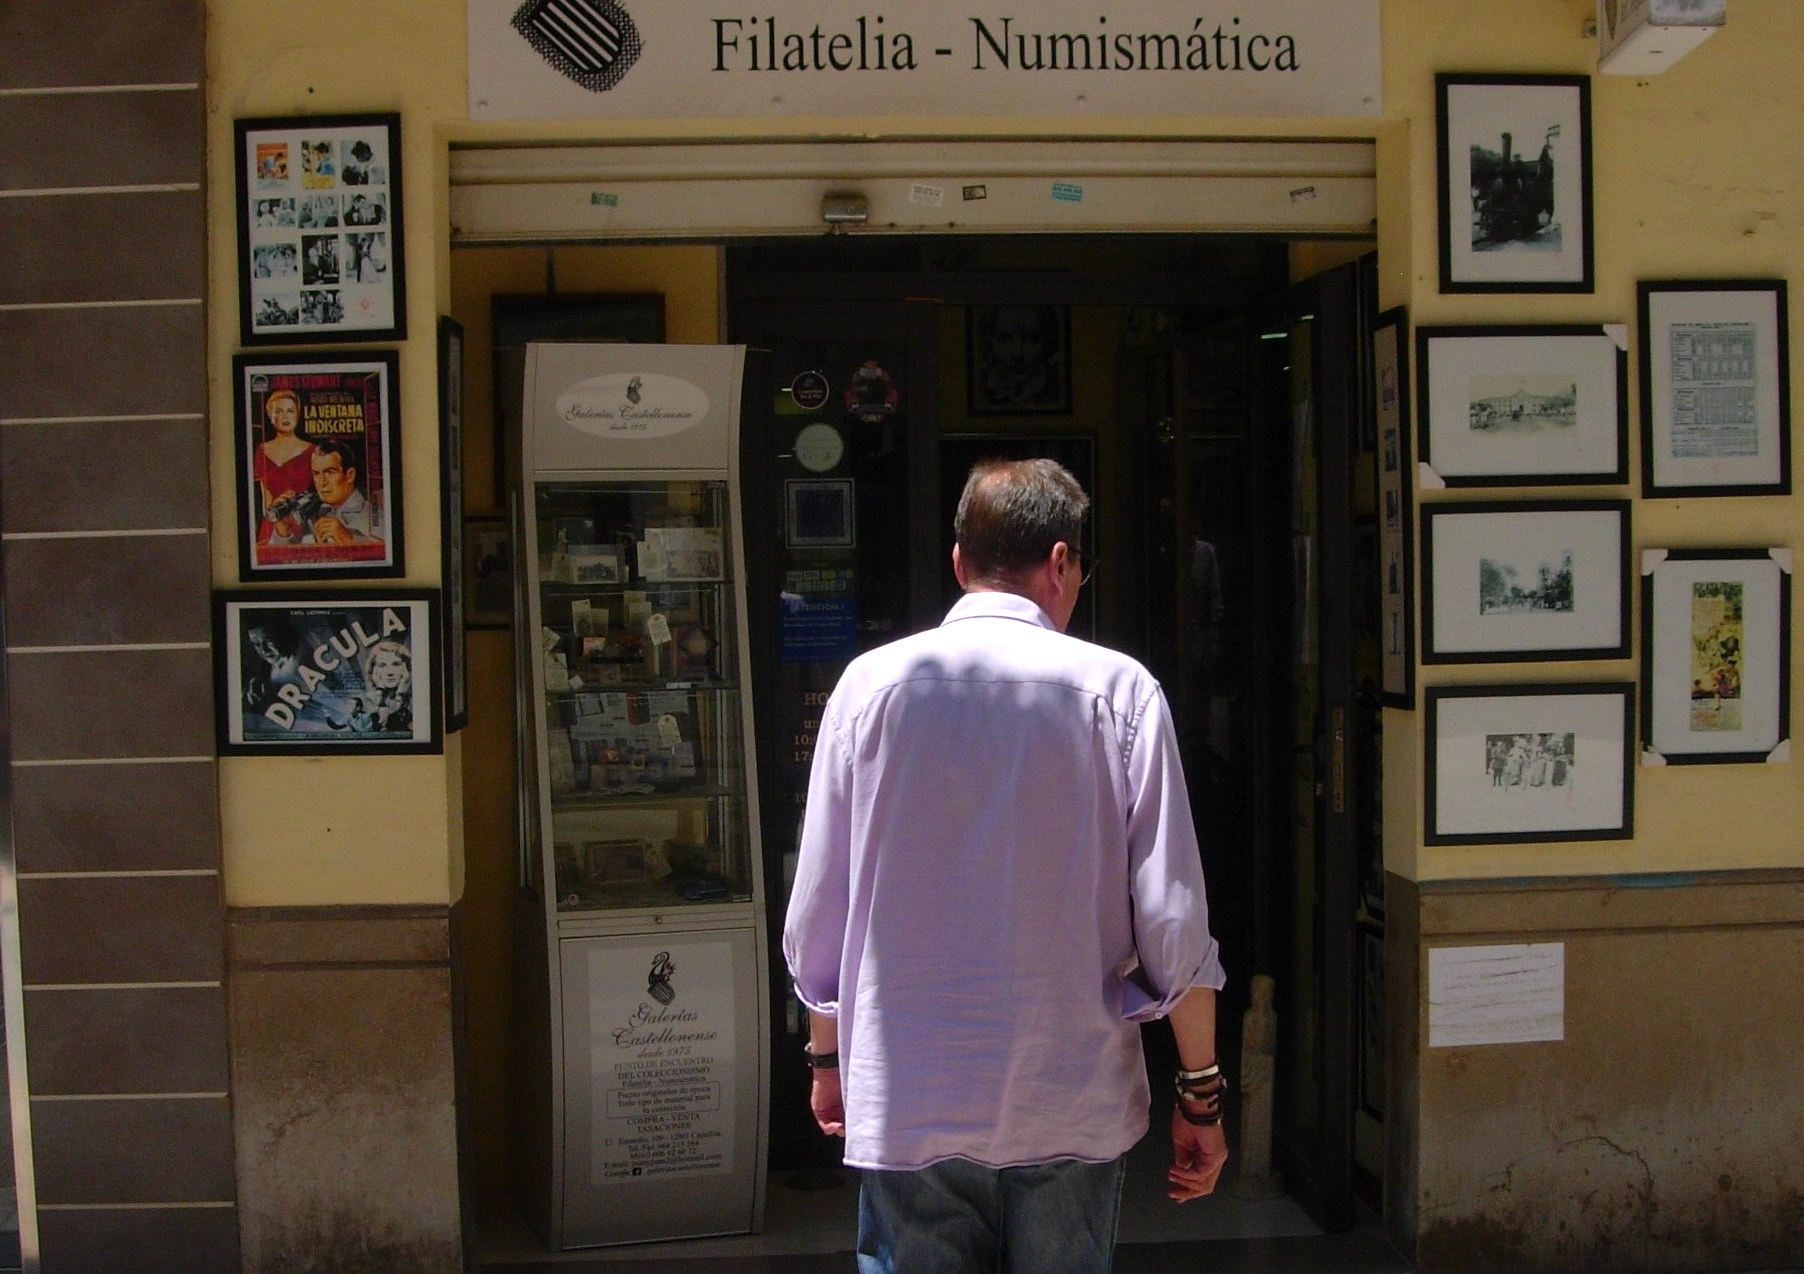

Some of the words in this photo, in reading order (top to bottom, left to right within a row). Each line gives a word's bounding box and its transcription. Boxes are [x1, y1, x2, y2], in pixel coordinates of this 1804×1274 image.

[711, 15, 918, 72] Filatelia
[935, 48, 953, 56] -
[968, 15, 1301, 72] Numismática
[304, 405, 318, 419] LA
[318, 404, 363, 418] VENTANA
[304, 418, 365, 434] INDISCRETA
[264, 607, 407, 730] DRACULA
[612, 1026, 718, 1048] Castellonense
[659, 1056, 714, 1067] ENCUENTRO
